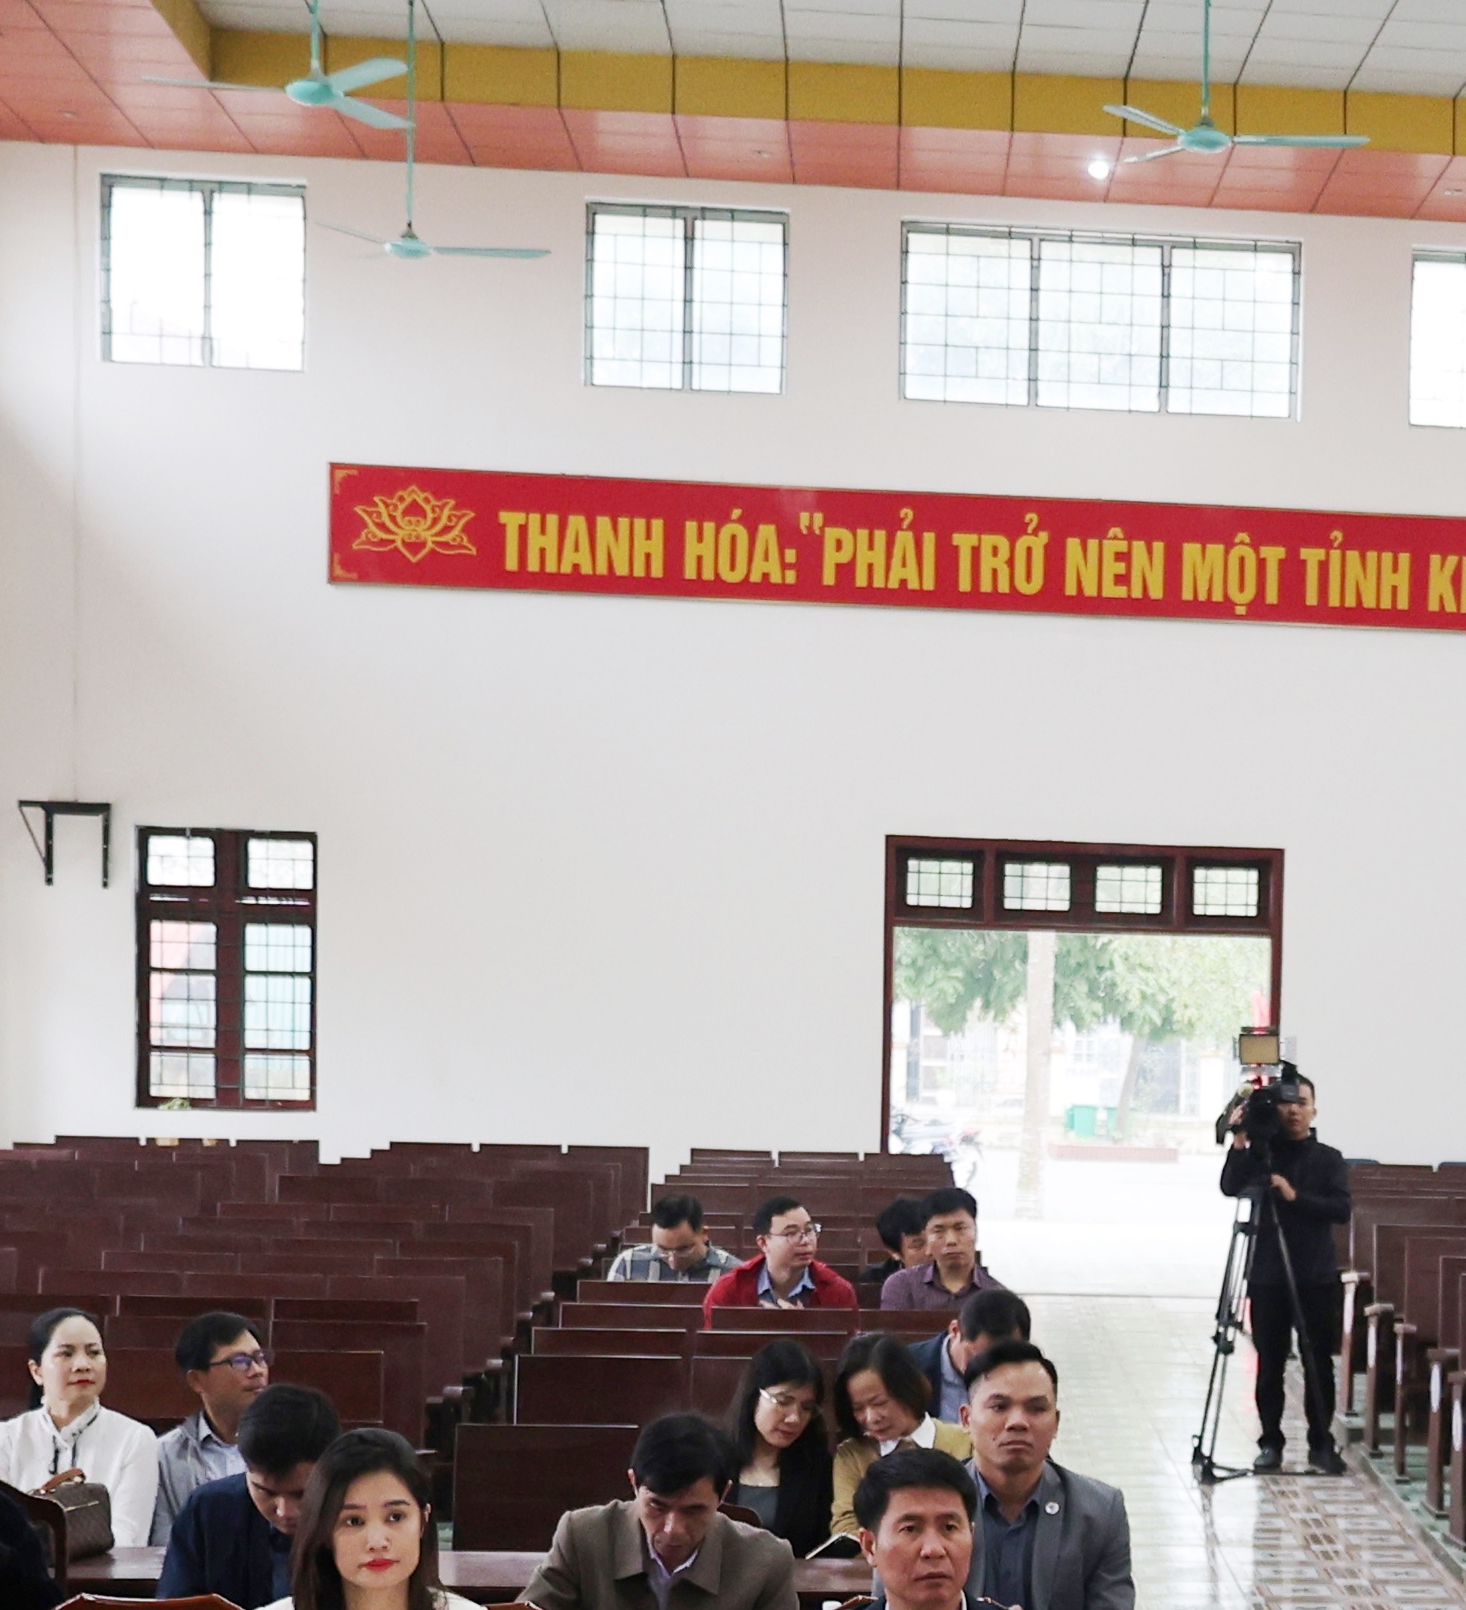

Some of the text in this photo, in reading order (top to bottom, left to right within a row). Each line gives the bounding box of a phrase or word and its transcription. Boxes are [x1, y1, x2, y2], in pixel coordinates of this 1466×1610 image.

[498, 511, 664, 577] THANH
[684, 509, 796, 584] HÓA:
[952, 512, 1049, 595] TRỞ
[1065, 527, 1164, 600] NÊN
[1181, 531, 1286, 616] MỘT
[1300, 530, 1410, 610] TỈNH
